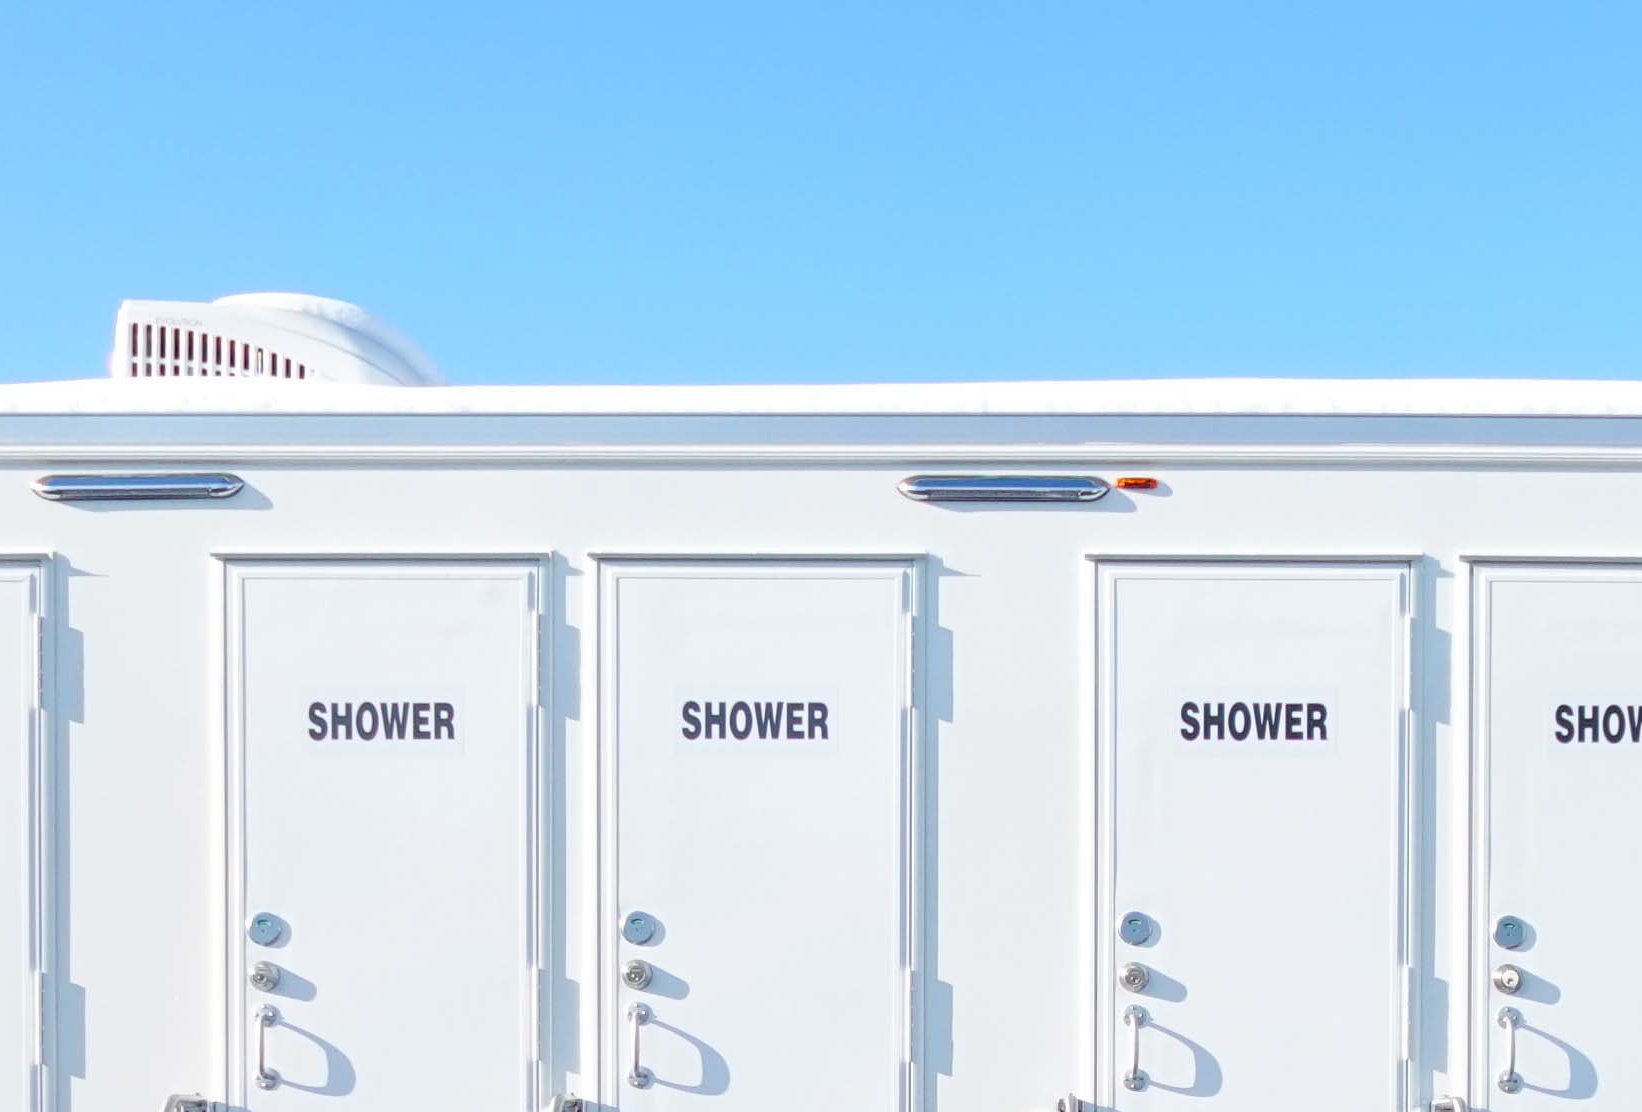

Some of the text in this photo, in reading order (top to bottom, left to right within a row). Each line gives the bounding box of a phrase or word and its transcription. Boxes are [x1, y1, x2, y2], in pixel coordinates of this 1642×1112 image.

[308, 702, 454, 741] SHOWER
[682, 701, 828, 740] SHOWER
[1180, 701, 1327, 741] SHOWER
